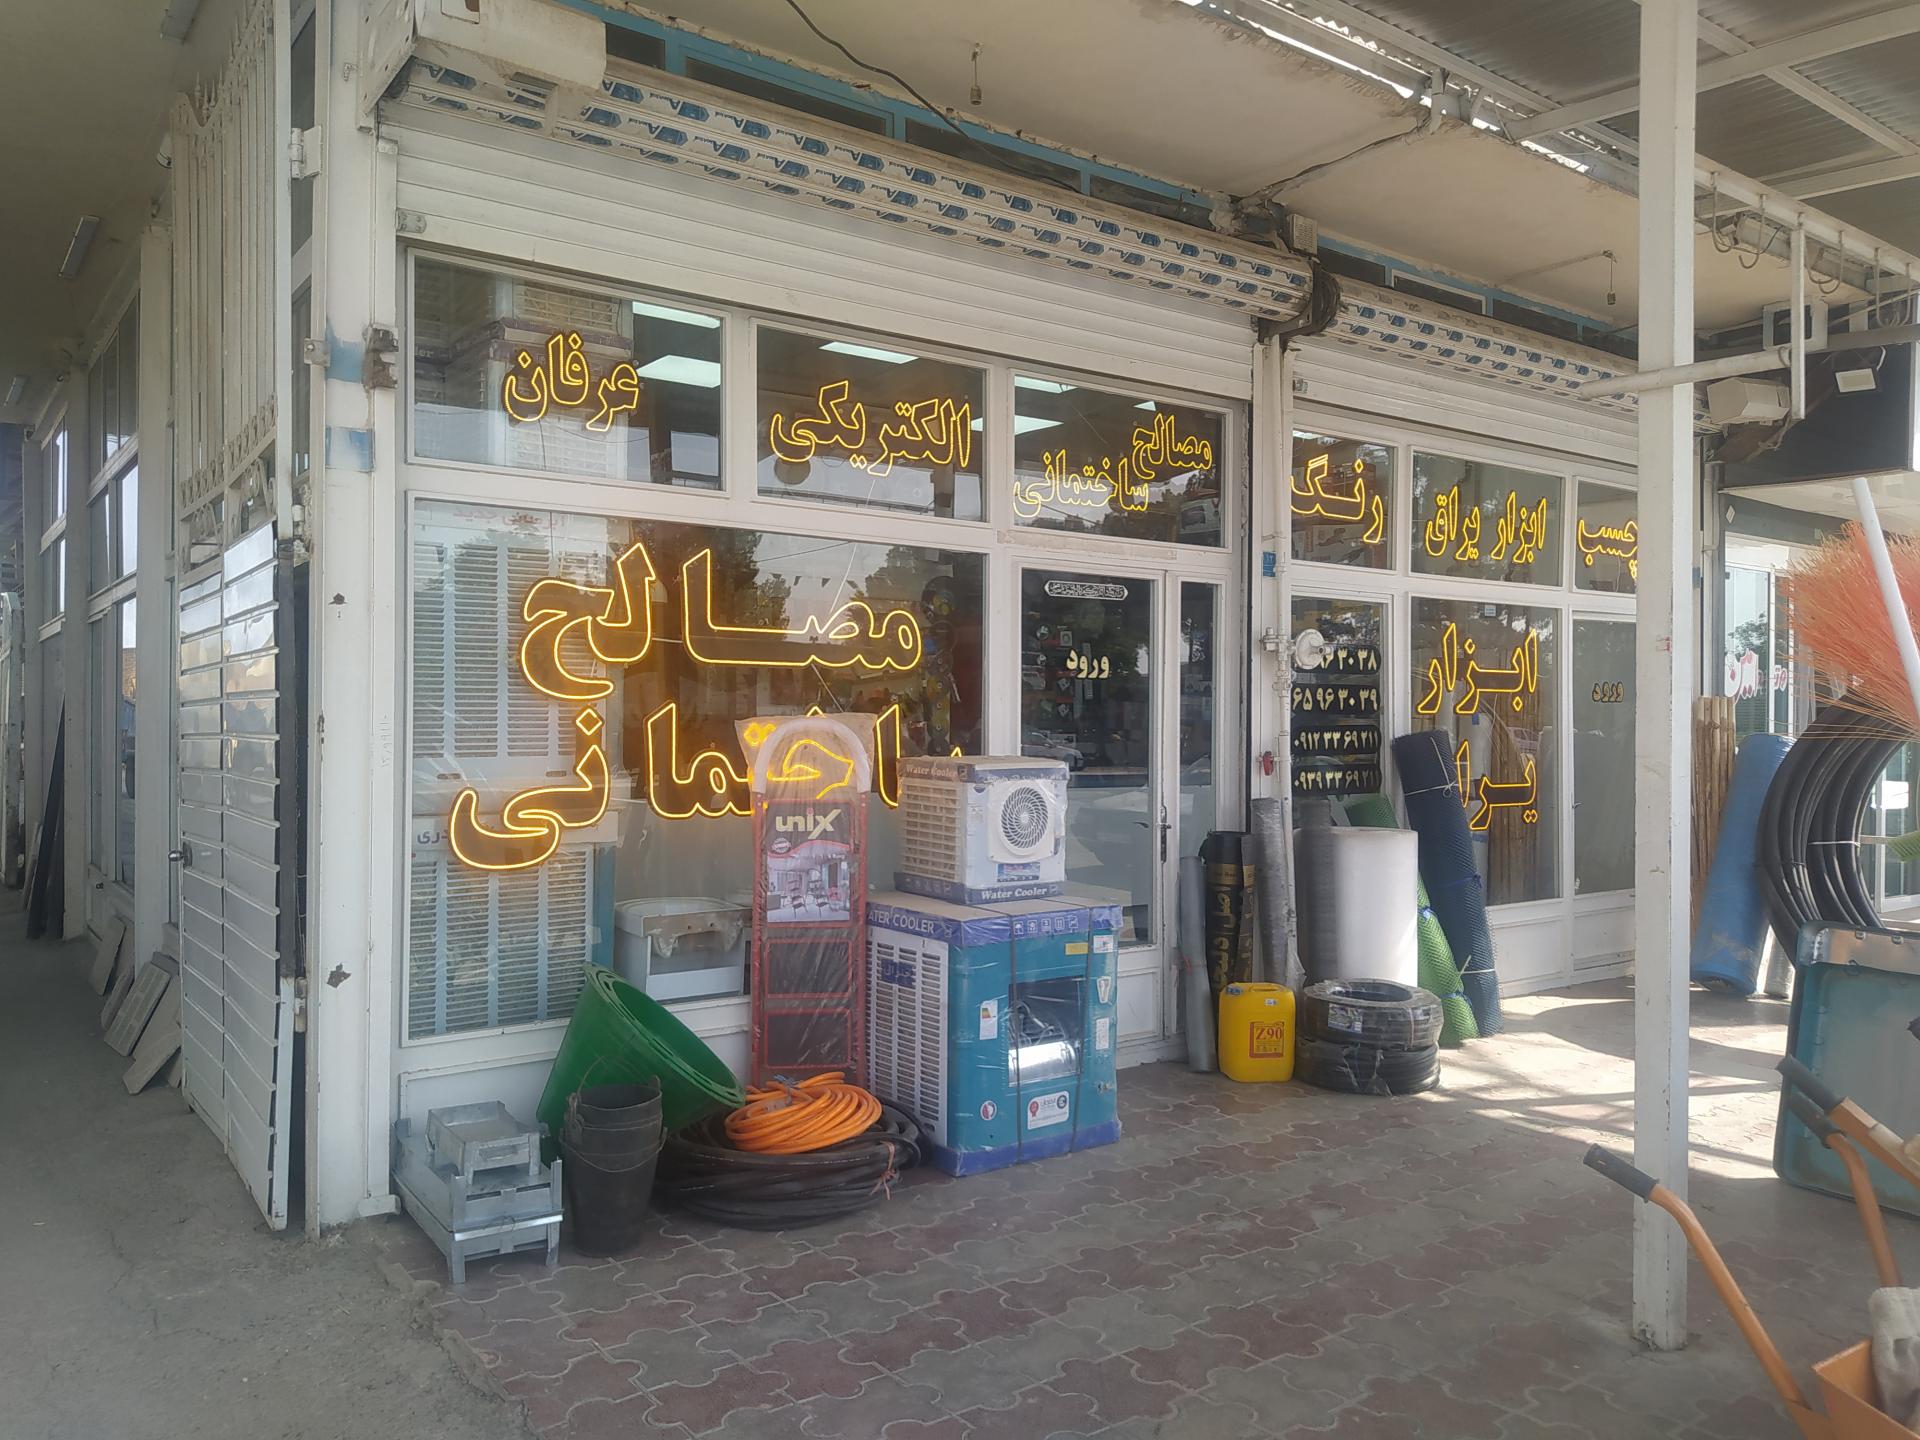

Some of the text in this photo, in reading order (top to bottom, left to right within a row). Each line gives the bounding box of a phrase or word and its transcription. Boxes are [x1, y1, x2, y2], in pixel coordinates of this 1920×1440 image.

[502, 331, 640, 432] عرفان
[769, 379, 972, 477] الکتریکی
[1131, 412, 1213, 480] مصالح
[1012, 448, 1149, 518] ساختمانی
[1289, 453, 1384, 544] رنگ
[1424, 485, 1547, 564] ابزار یراق
[521, 542, 922, 699] مصالح
[1065, 648, 1110, 679] ورود
[1417, 622, 1537, 714] ابزار
[449, 696, 963, 870] اختمانی
[906, 764, 930, 775] Water
[1456, 740, 1538, 831] یرا
[775, 807, 841, 840] unix
[868, 909, 935, 934] ATER COOLER
[981, 886, 1048, 900] Water Cooler
[1256, 1026, 1283, 1041] Z90
